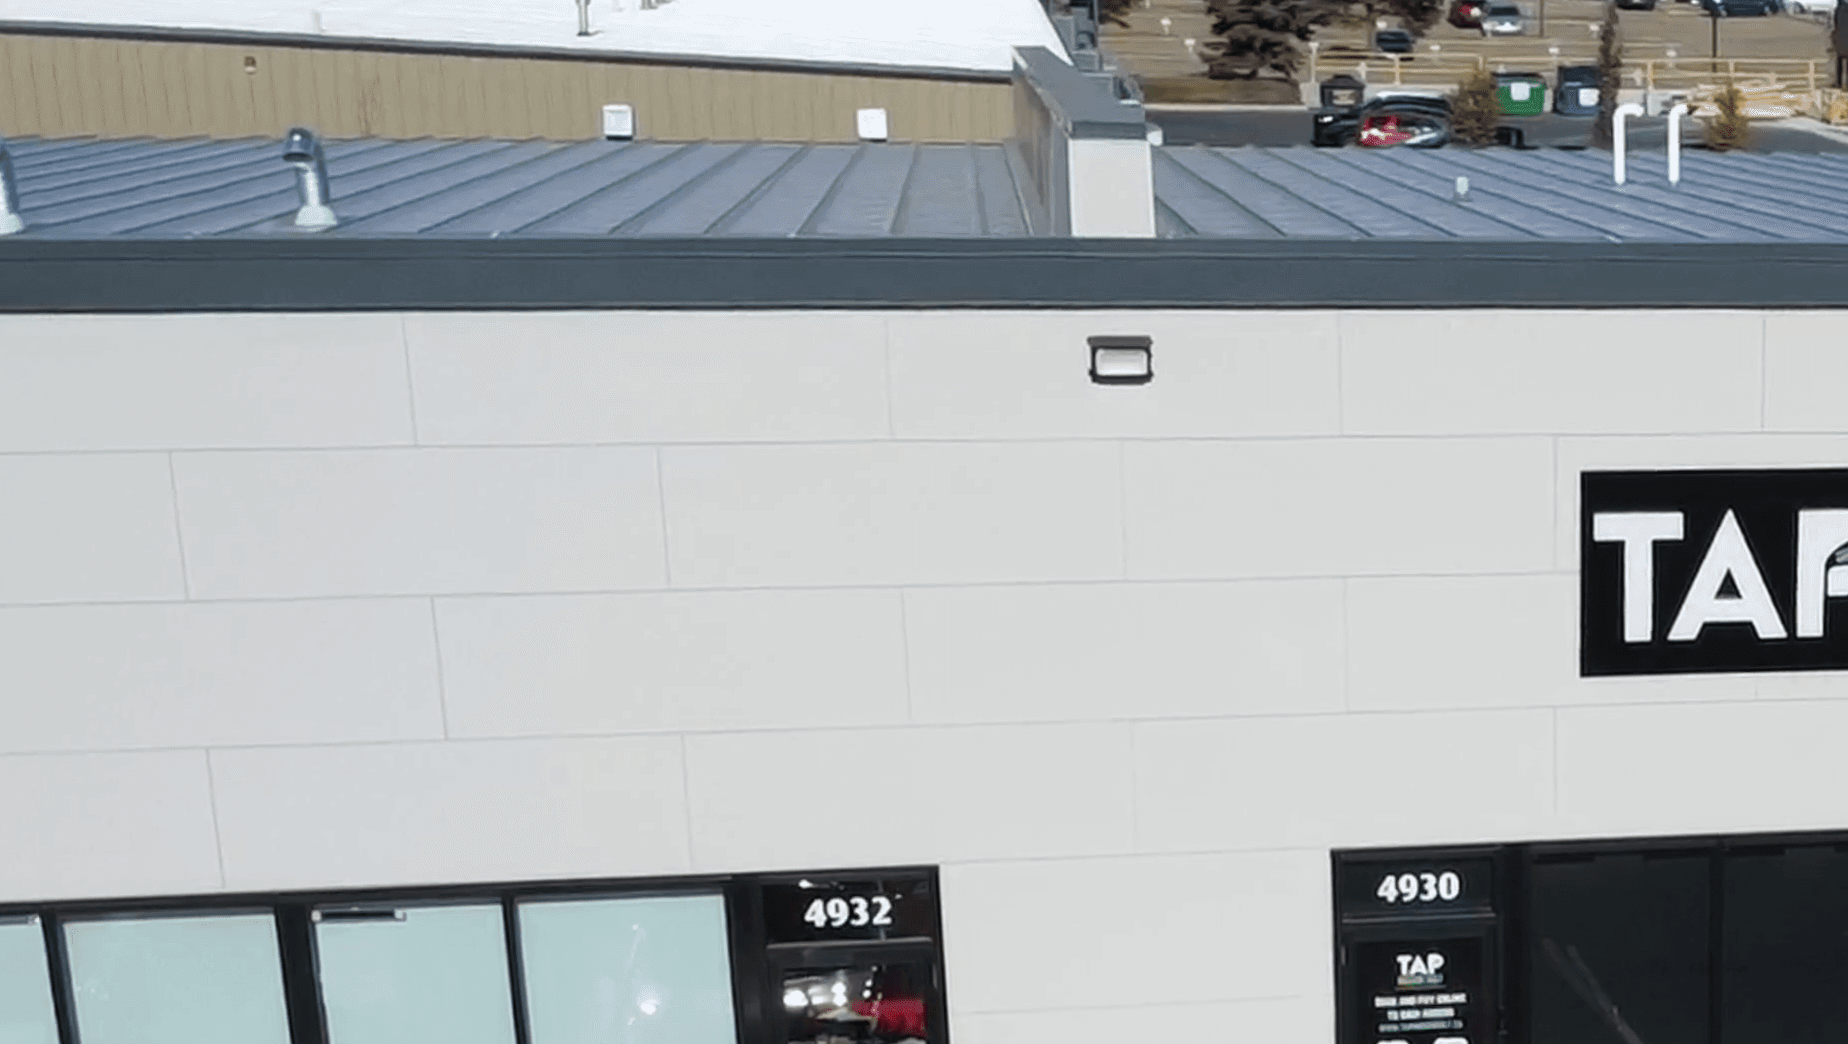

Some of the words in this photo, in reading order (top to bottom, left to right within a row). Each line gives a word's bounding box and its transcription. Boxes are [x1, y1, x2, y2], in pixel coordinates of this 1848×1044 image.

[1377, 872, 1460, 903] 4930
[804, 896, 892, 928] 4932
[1396, 953, 1445, 976] TAP
